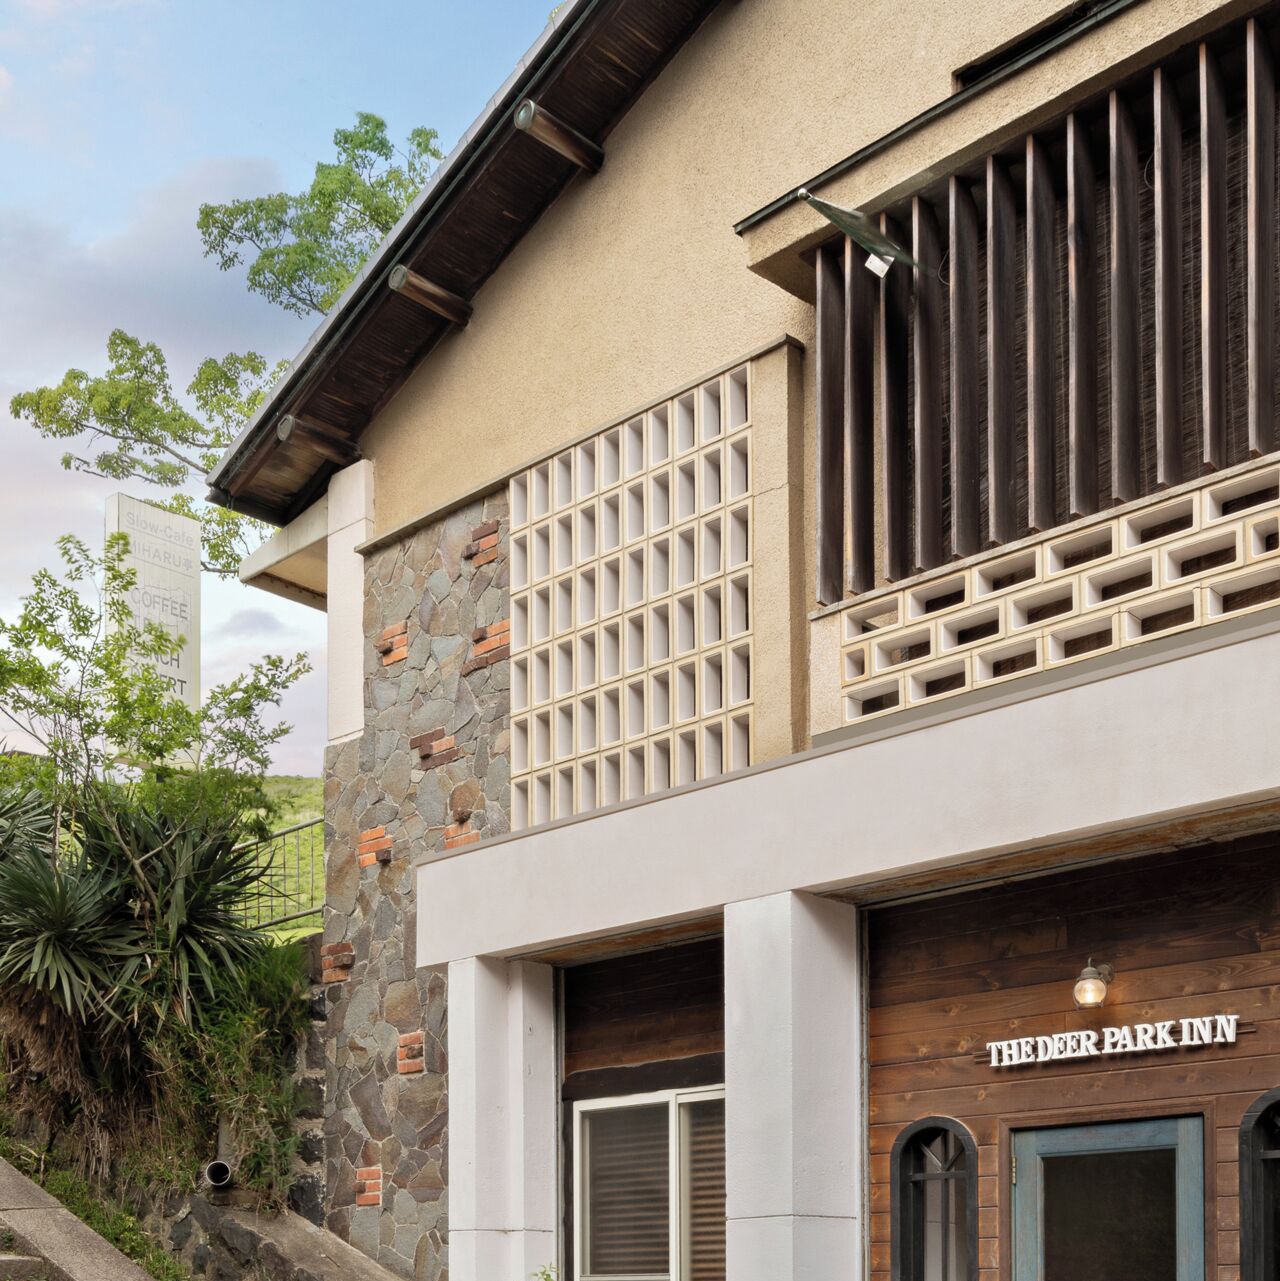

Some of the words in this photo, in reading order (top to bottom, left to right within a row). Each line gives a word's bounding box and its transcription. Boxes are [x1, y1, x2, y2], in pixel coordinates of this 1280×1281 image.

[130, 587, 188, 620] COFFEE
[985, 1036, 1036, 1067] THE
[1036, 1030, 1101, 1063] DEER
[1101, 1020, 1179, 1054] PARK
[1179, 1014, 1240, 1046] INN
